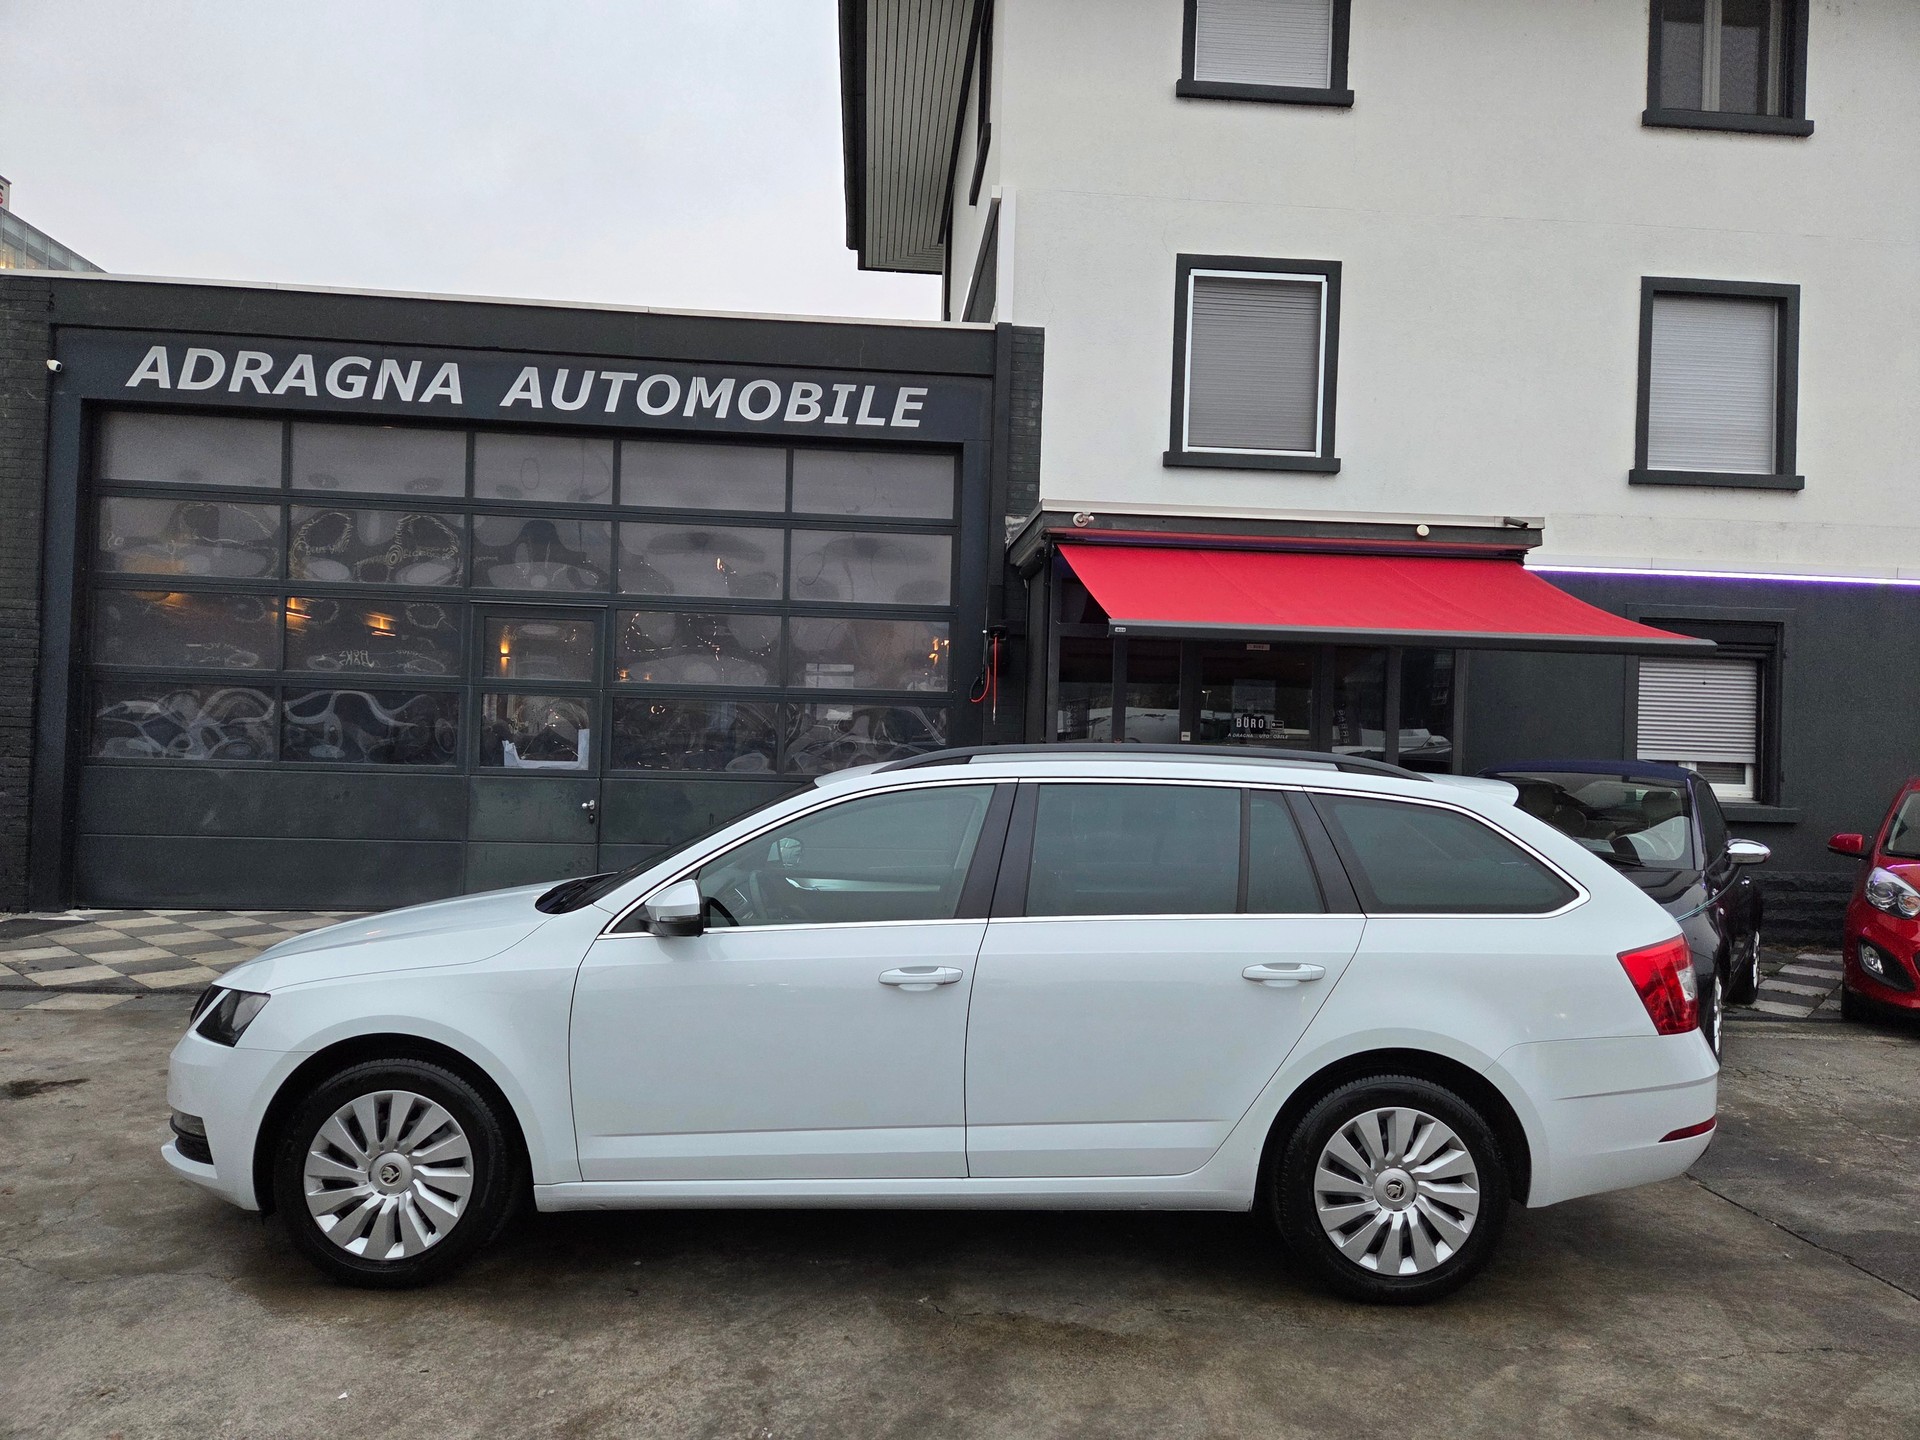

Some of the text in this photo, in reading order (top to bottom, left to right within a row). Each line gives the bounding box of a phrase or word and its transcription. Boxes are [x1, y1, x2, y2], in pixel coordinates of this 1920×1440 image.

[125, 345, 930, 428] ADRAGNA AUTOMOBILE
[1236, 717, 1264, 728] BÜRO
